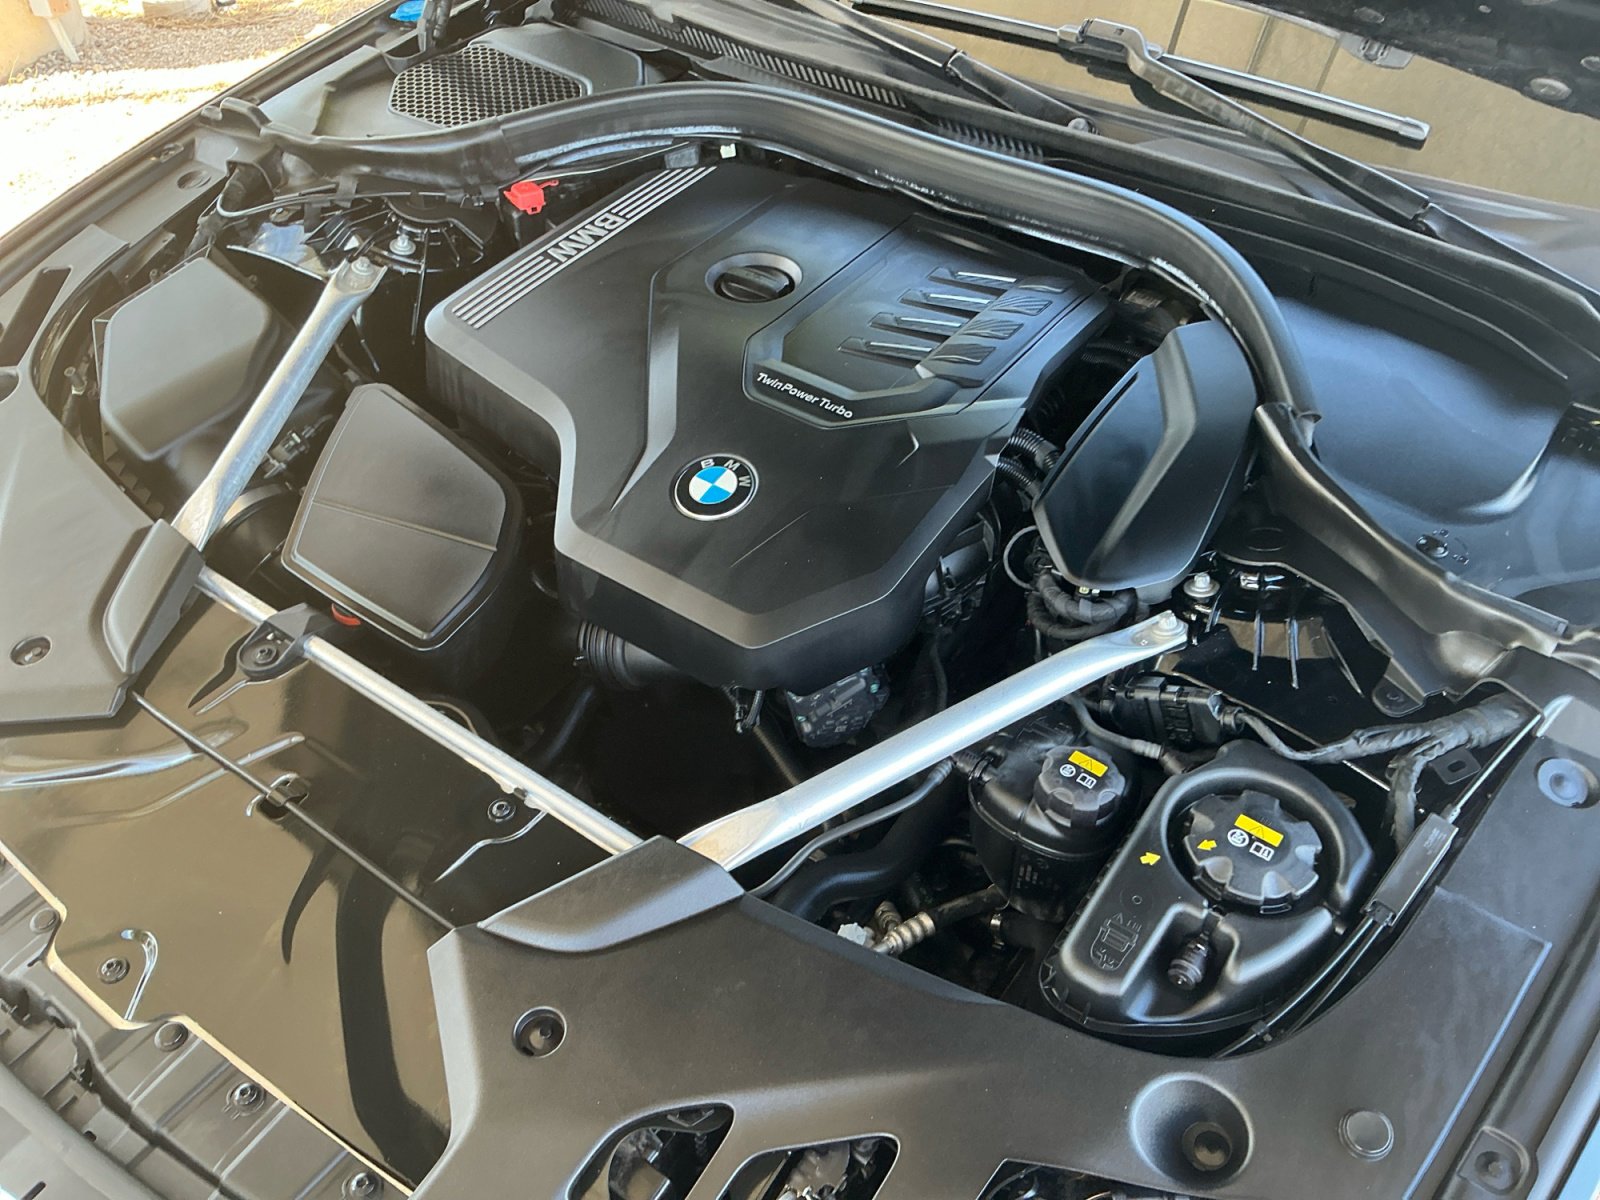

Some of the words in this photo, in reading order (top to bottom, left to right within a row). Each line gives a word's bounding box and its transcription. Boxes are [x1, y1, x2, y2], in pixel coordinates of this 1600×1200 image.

[547, 212, 628, 263] BMW
[756, 372, 820, 404] TwinPower
[819, 397, 854, 419] Turbo
[700, 458, 752, 488] BMW
